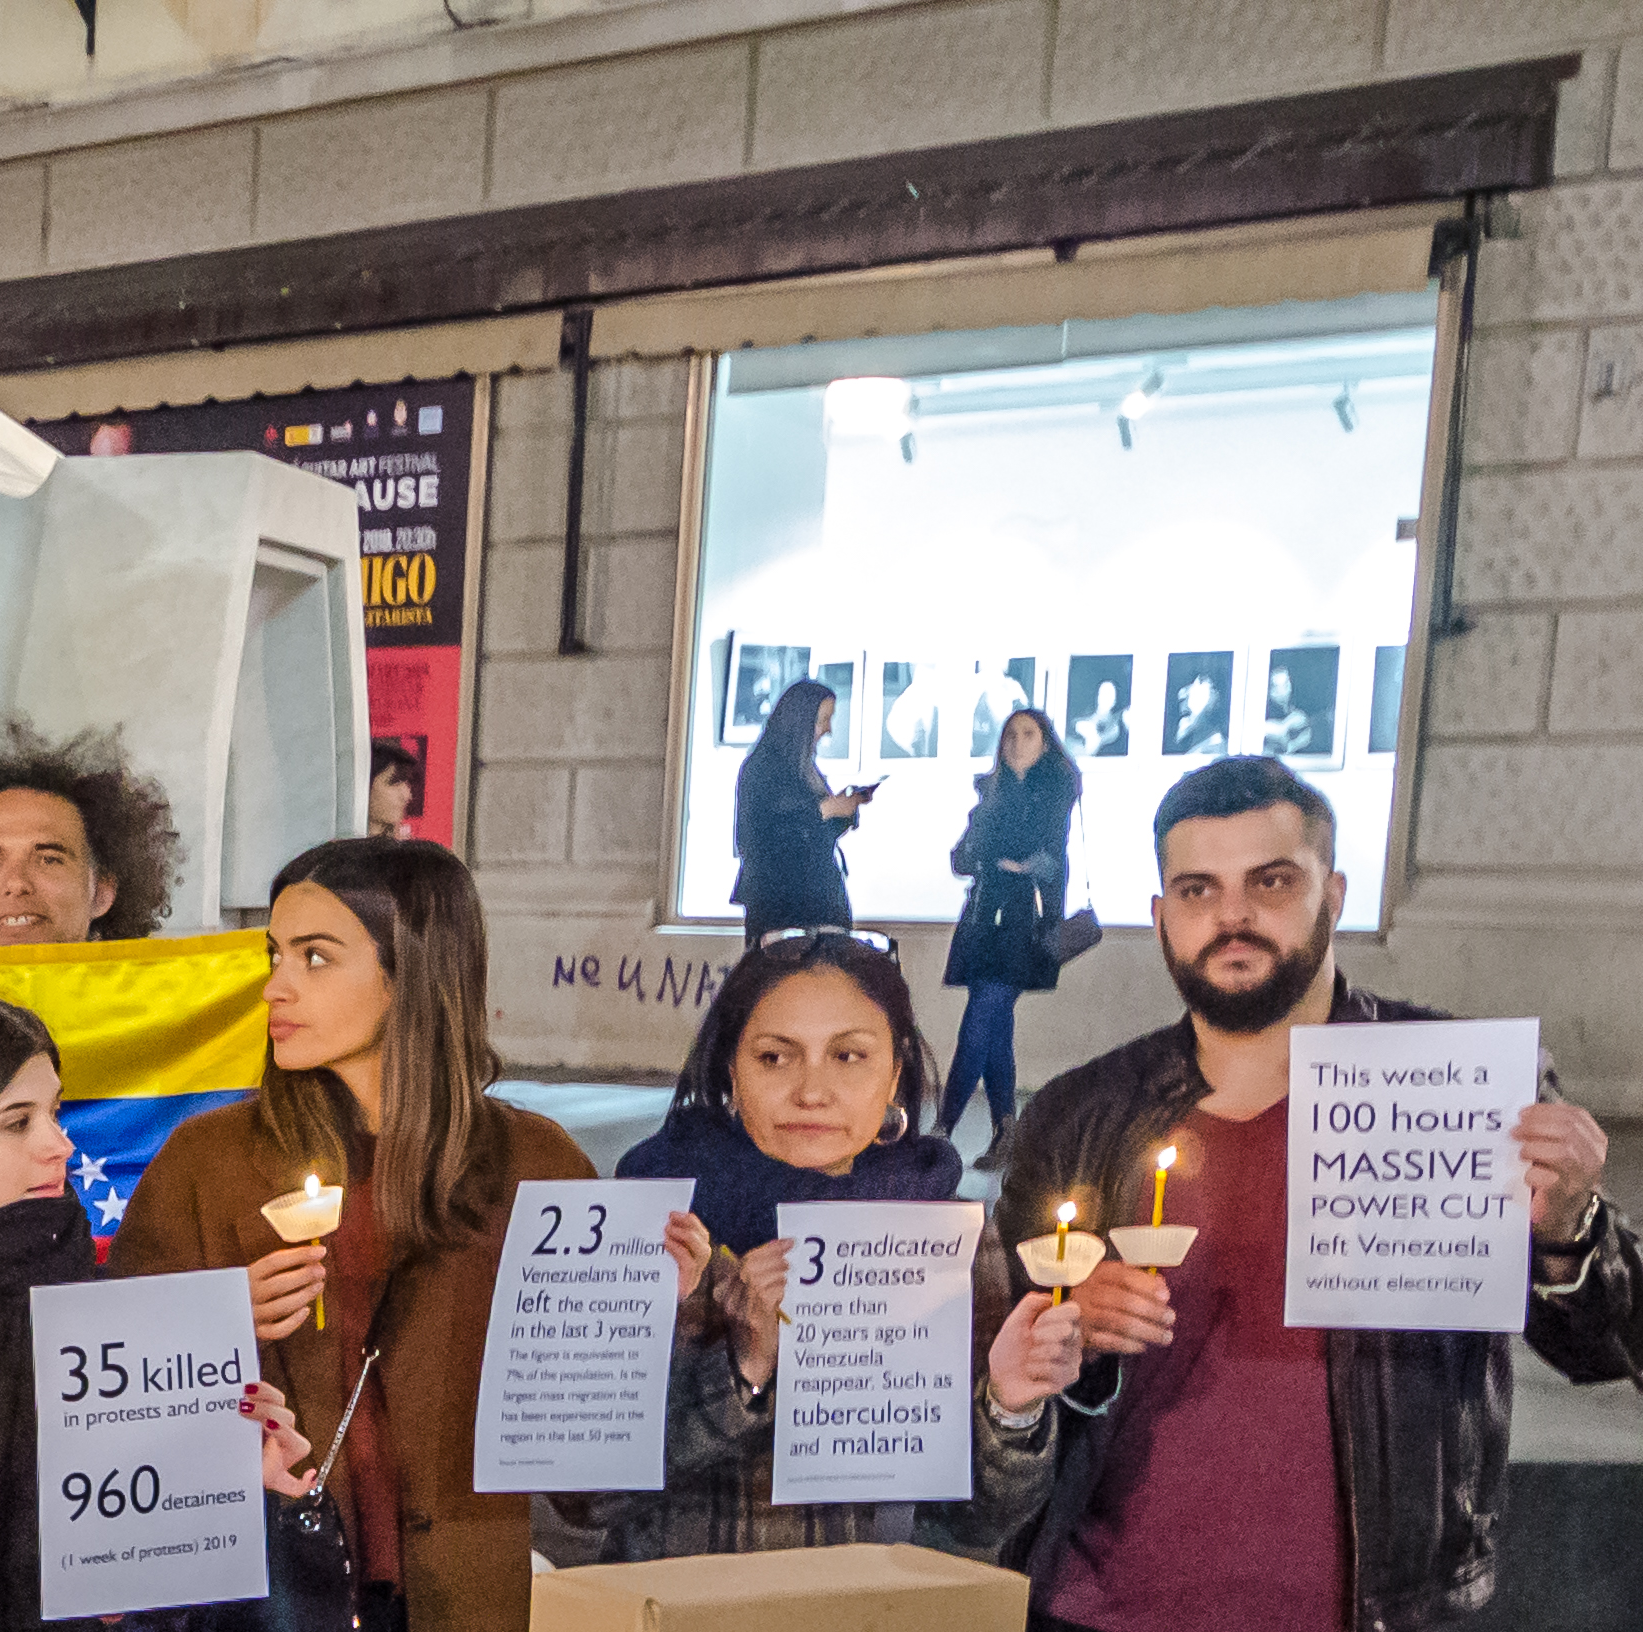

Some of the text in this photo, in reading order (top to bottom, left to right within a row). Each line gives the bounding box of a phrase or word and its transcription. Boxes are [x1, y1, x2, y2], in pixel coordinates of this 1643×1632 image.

[1310, 1059, 1489, 1088] This week a
[1312, 1100, 1503, 1134] 100 hours
[1312, 1148, 1494, 1183] MASSIVE
[1311, 1193, 1513, 1220] POWER CUT
[531, 1204, 666, 1257] 2.3 million
[1309, 1232, 1491, 1258] left Venezuela
[799, 1233, 963, 1286] 3 eradicated
[521, 1264, 661, 1284] Venezuelans have
[832, 1263, 927, 1288] diseases
[1305, 1272, 1485, 1299] without electricity
[515, 1289, 653, 1319] left the country
[795, 1296, 888, 1317] more than
[510, 1320, 525, 1340] in
[530, 1319, 558, 1340] the
[561, 1319, 589, 1340] last
[795, 1322, 929, 1347] 20 years ago in
[59, 1340, 242, 1402] 35 killed
[793, 1347, 884, 1370] Venezuela
[882, 1370, 927, 1391] Such
[933, 1372, 953, 1390] as
[64, 1398, 200, 1431] in protests and
[792, 1399, 942, 1428] tuberculosis
[789, 1430, 925, 1457] and malaria
[61, 1464, 247, 1522] 960 detainees
[79, 1549, 118, 1567] week
[121, 1545, 136, 1563] of
[203, 1533, 238, 1551] 2019
